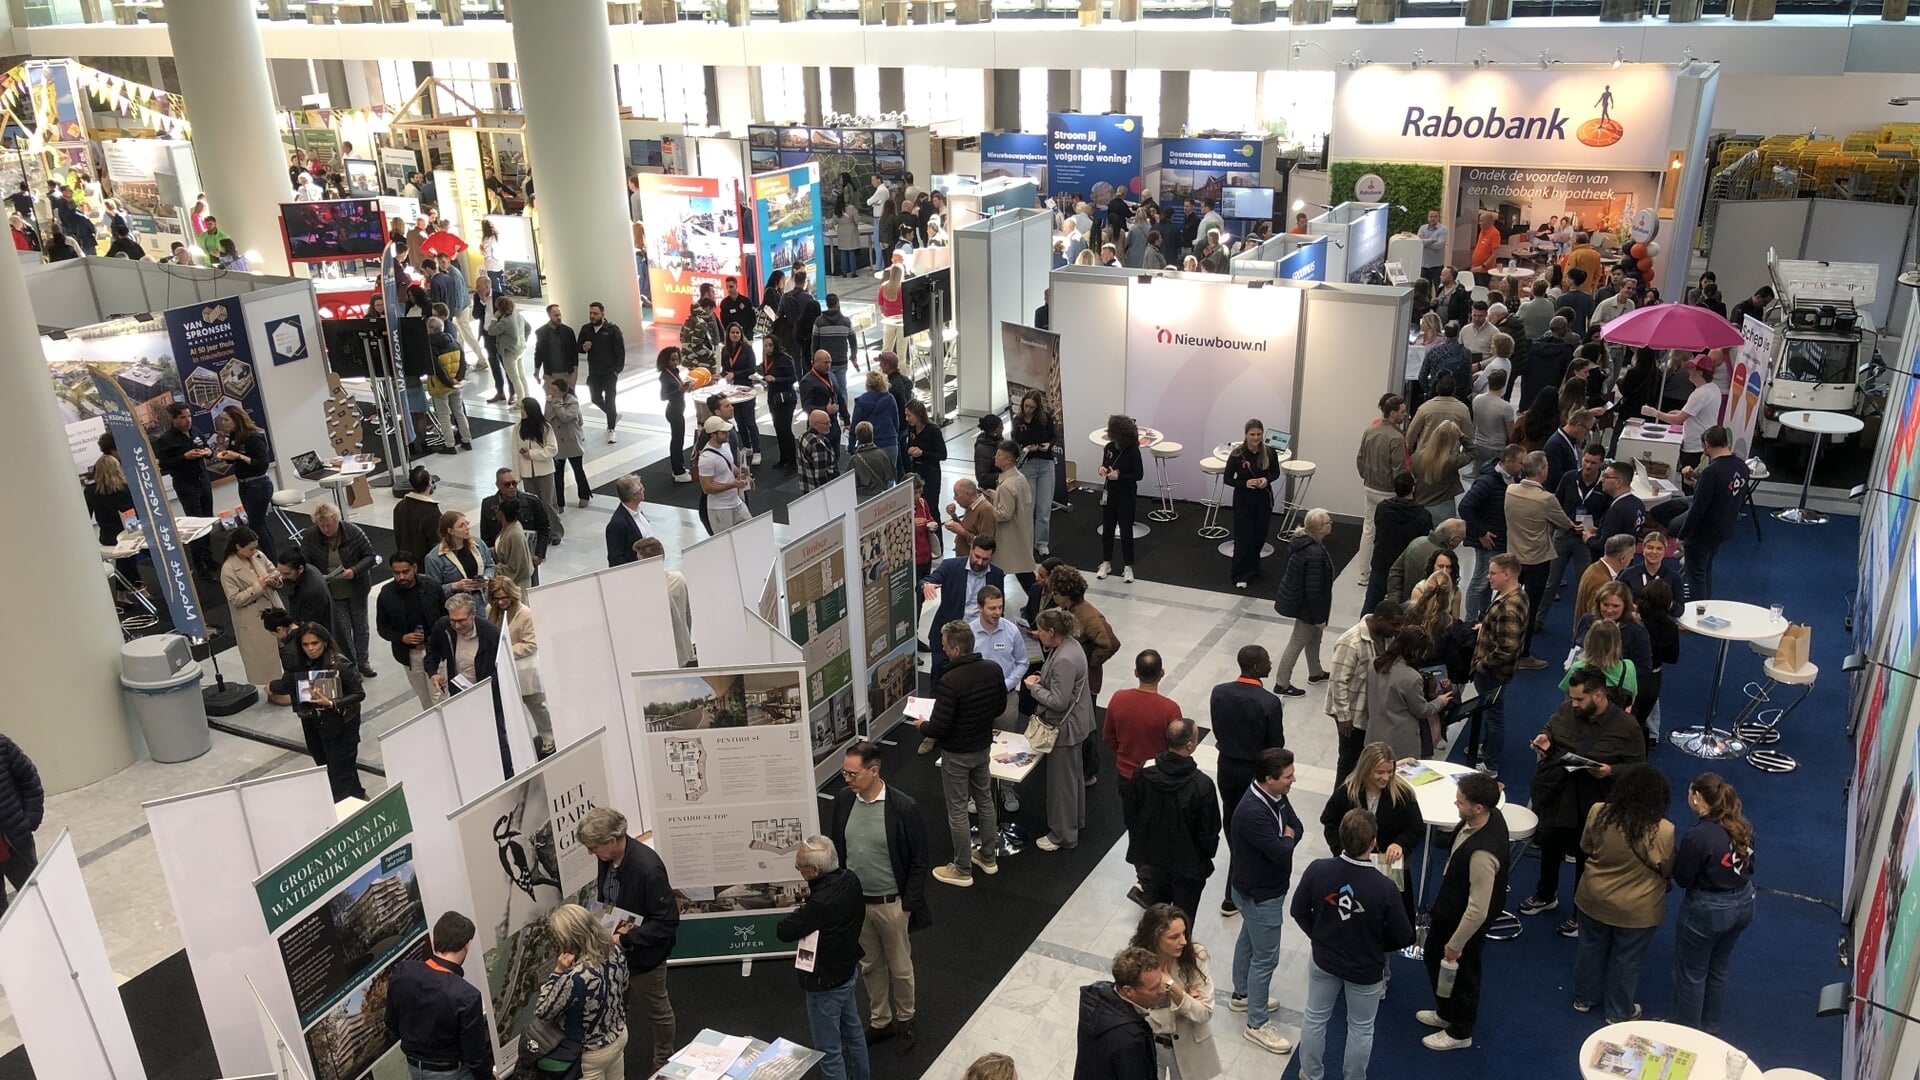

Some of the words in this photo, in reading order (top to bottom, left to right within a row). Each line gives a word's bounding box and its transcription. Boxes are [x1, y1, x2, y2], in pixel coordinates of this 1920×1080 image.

[1401, 106, 1570, 140] Rabobank
[1054, 130, 1087, 140] Stroom
[1087, 130, 1097, 142] jij
[1054, 141, 1075, 151] door
[1076, 142, 1097, 151] naar
[1097, 142, 1107, 153] je
[1169, 151, 1212, 159] Doorstromen
[987, 152, 1048, 161] Nieuwbouwprojecten
[1054, 152, 1094, 164] volgende
[1096, 153, 1133, 165] woning?
[1169, 158, 1178, 166] bij
[1178, 159, 1211, 167] Woonstad
[1212, 160, 1251, 168] Rotterdam.
[1469, 168, 1506, 182] Ondek
[1508, 169, 1524, 182] de
[1525, 170, 1584, 185] voordelen
[1586, 174, 1608, 185] van
[1467, 186, 1489, 196] een
[1490, 184, 1549, 199] Rabobank
[1551, 186, 1617, 201] hypotheek.
[664, 283, 725, 299] VLAARDEN
[183, 320, 203, 332] VAN
[185, 323, 231, 340] SPRONSEN
[1174, 333, 1267, 352] Nieuwbouw.nl
[1742, 325, 1763, 351] Schep
[190, 347, 198, 356] Al
[198, 346, 205, 355] 50
[206, 344, 219, 354] jaar
[219, 340, 235, 349] thuis
[392, 329, 406, 393] Welkom
[716, 736, 760, 744] PENTHOUSE
[553, 782, 585, 813] HET
[556, 795, 596, 833] PARK
[668, 815, 711, 823] PENTHOUSE
[714, 813, 728, 821] TOP
[279, 855, 324, 894] GROEN
[325, 822, 371, 860] WONEN
[372, 811, 387, 829] IN
[271, 854, 350, 917] WATERRIJKE
[351, 819, 400, 860] WEELDE
[729, 940, 764, 949] JUFFER
